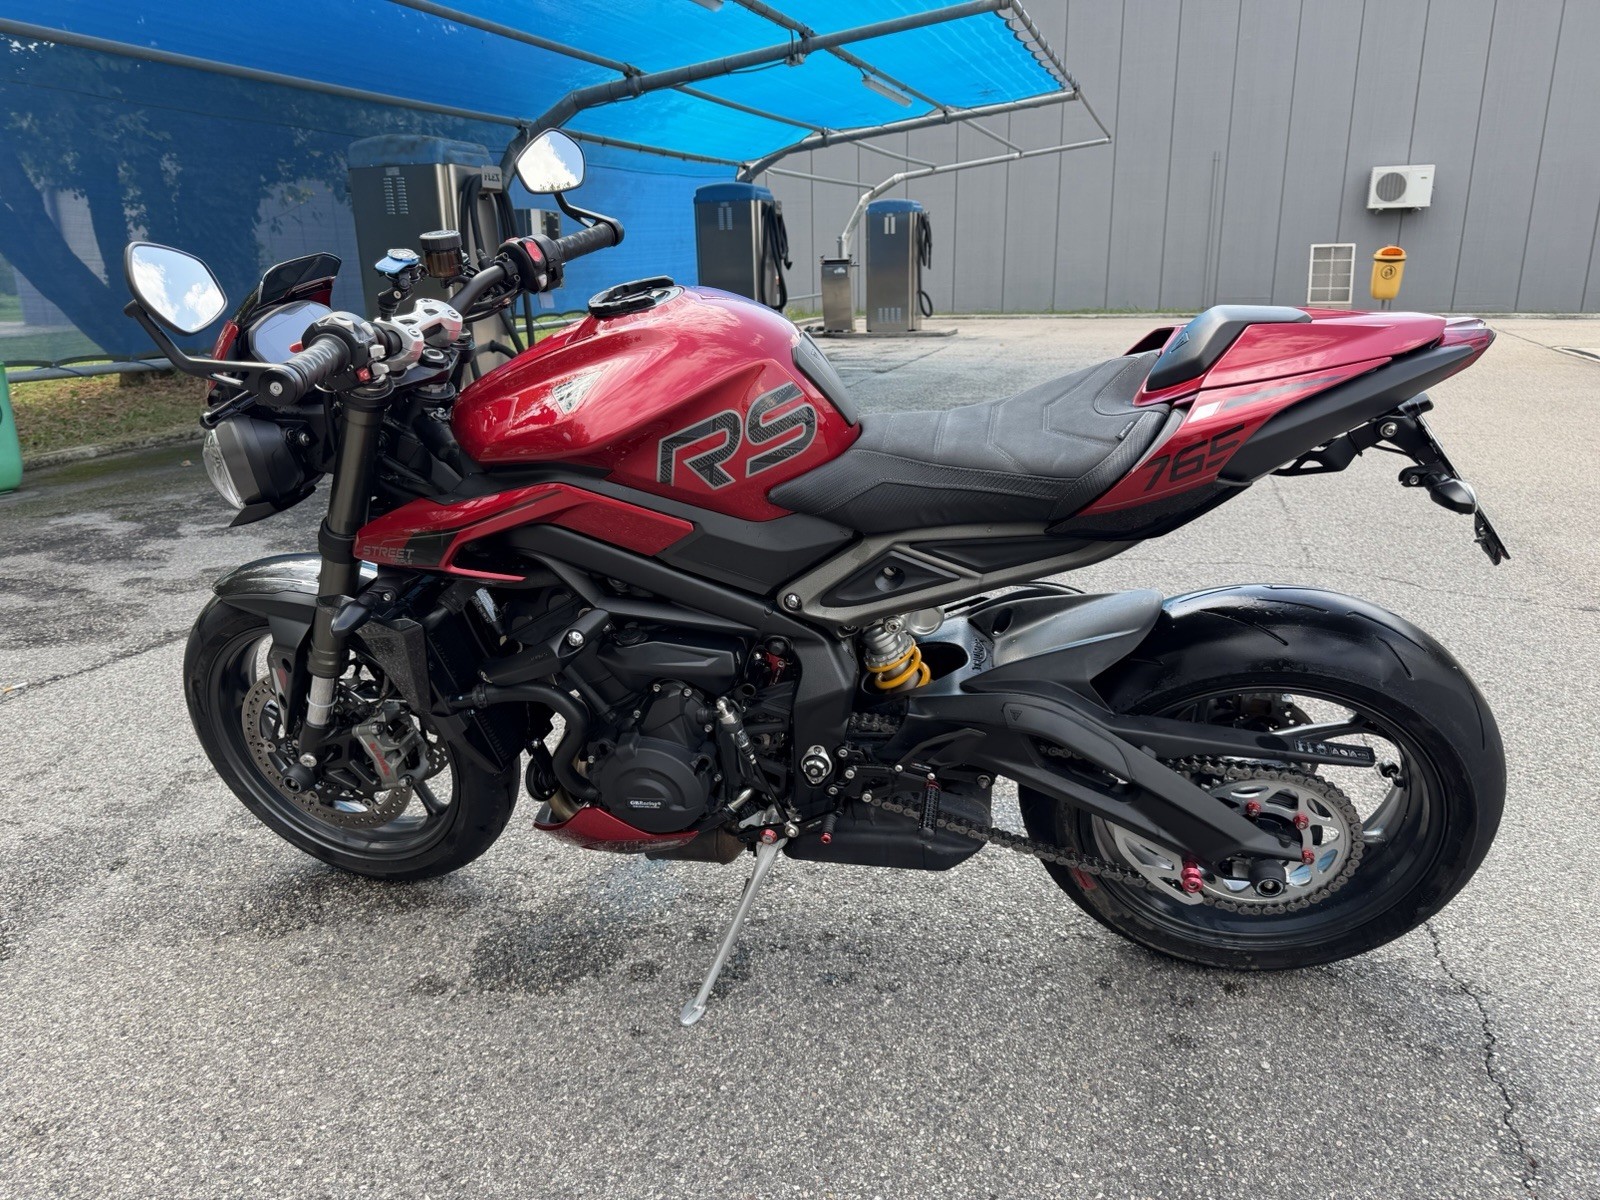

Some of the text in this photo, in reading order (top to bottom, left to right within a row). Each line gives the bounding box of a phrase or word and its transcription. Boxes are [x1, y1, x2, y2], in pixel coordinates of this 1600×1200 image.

[656, 381, 818, 491] RS
[1143, 423, 1245, 492] 765
[363, 545, 415, 559] STREET
